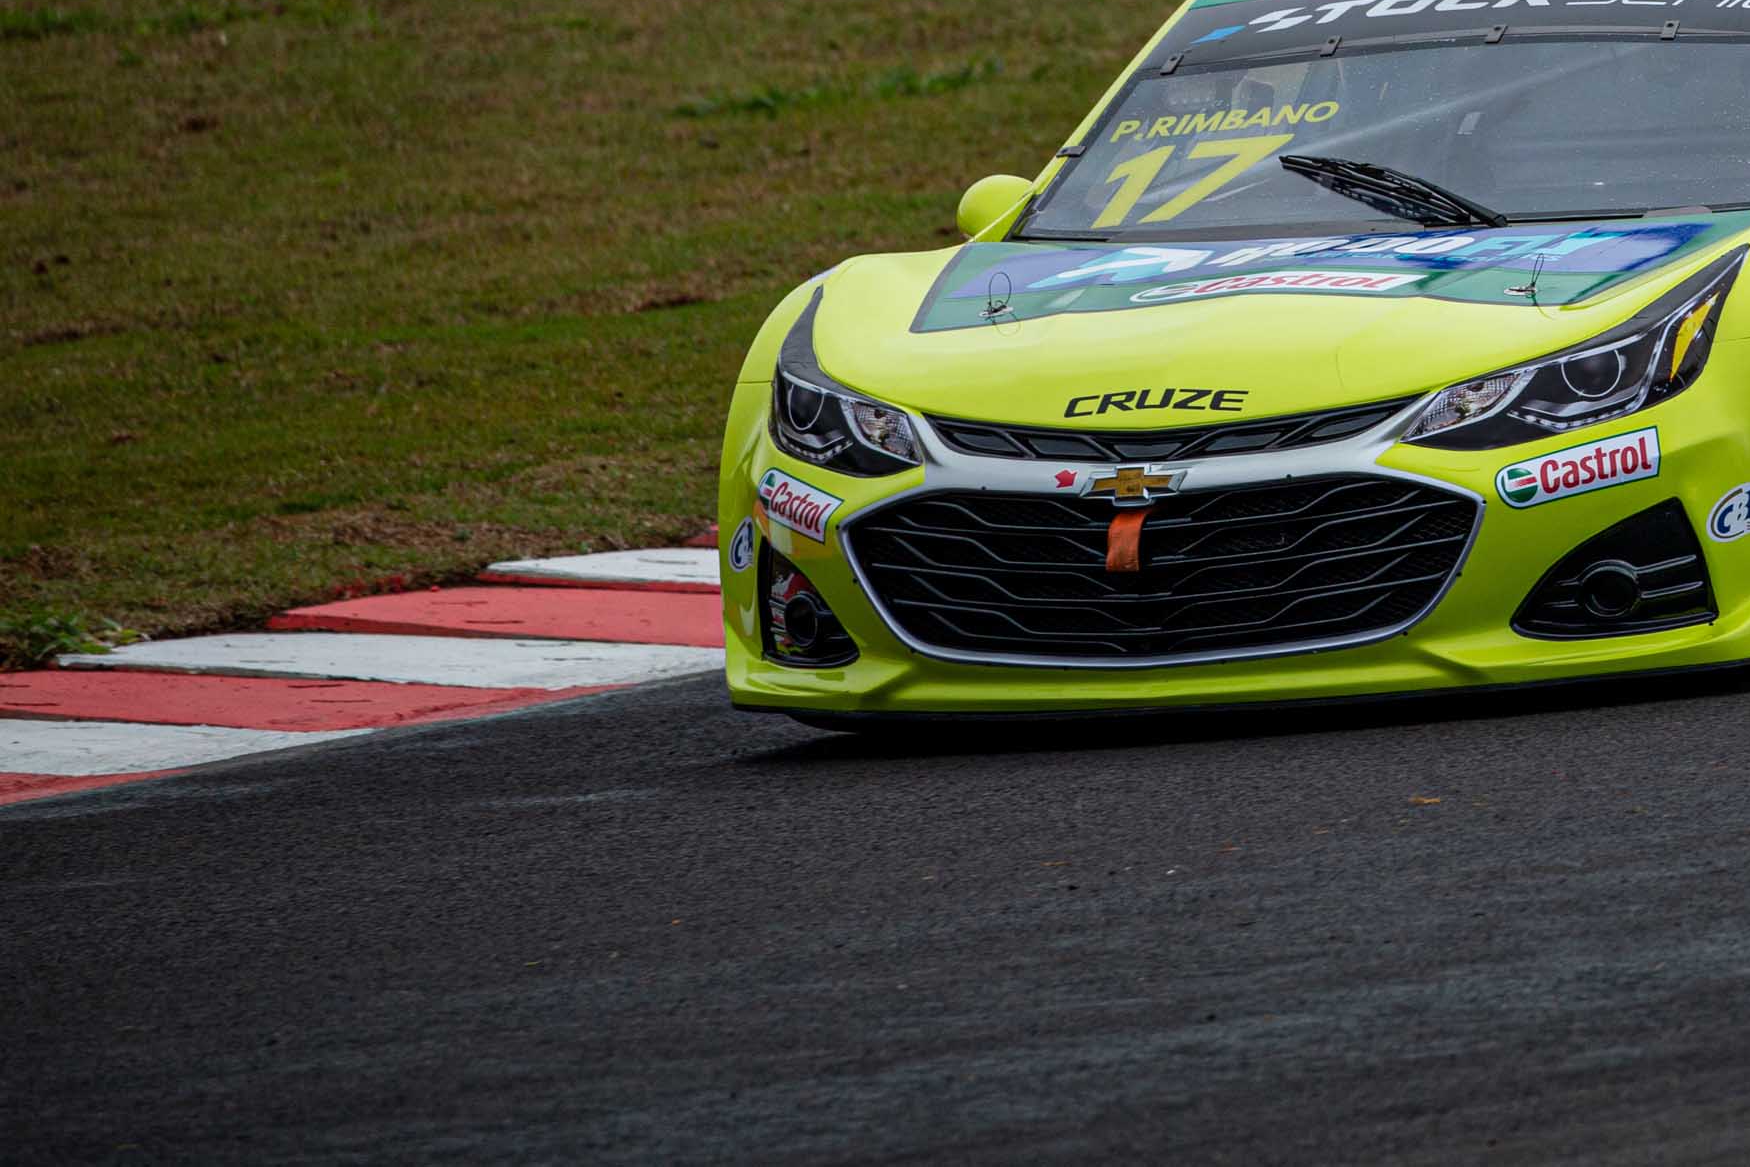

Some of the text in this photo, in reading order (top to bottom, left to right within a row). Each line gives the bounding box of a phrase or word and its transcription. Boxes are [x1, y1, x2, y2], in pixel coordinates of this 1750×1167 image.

[1110, 101, 1340, 143] P.RIMBANO
[1091, 133, 1295, 230] 17
[1194, 272, 1394, 294] Castrol
[1064, 388, 1250, 419] CRUZE
[1539, 436, 1652, 495] Castrol
[771, 481, 832, 534] Castrol
